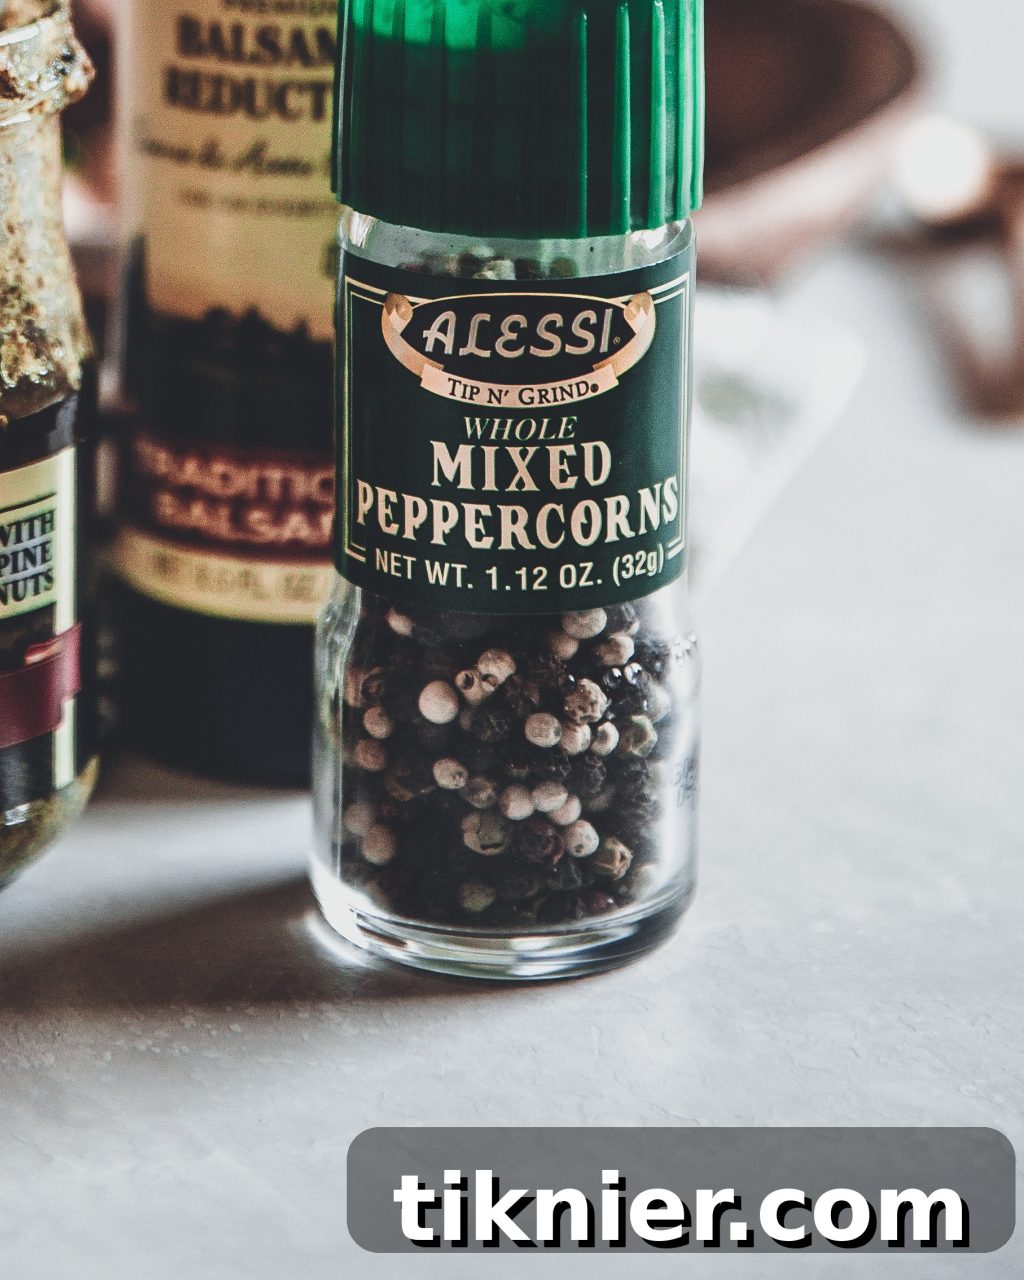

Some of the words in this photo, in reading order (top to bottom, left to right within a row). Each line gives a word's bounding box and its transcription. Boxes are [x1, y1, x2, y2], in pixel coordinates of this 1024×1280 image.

[422, 308, 613, 359] ALESSI
[447, 377, 480, 401] TIP
[463, 416, 577, 441] WHOLE
[430, 440, 612, 492] MIXED
[356, 474, 679, 551] PEPPERCORNS
[375, 548, 416, 580] NET
[424, 559, 474, 589] WT.
[485, 566, 548, 591] 1.12
[559, 561, 602, 589] OZ.
[612, 542, 664, 586] (32g)
